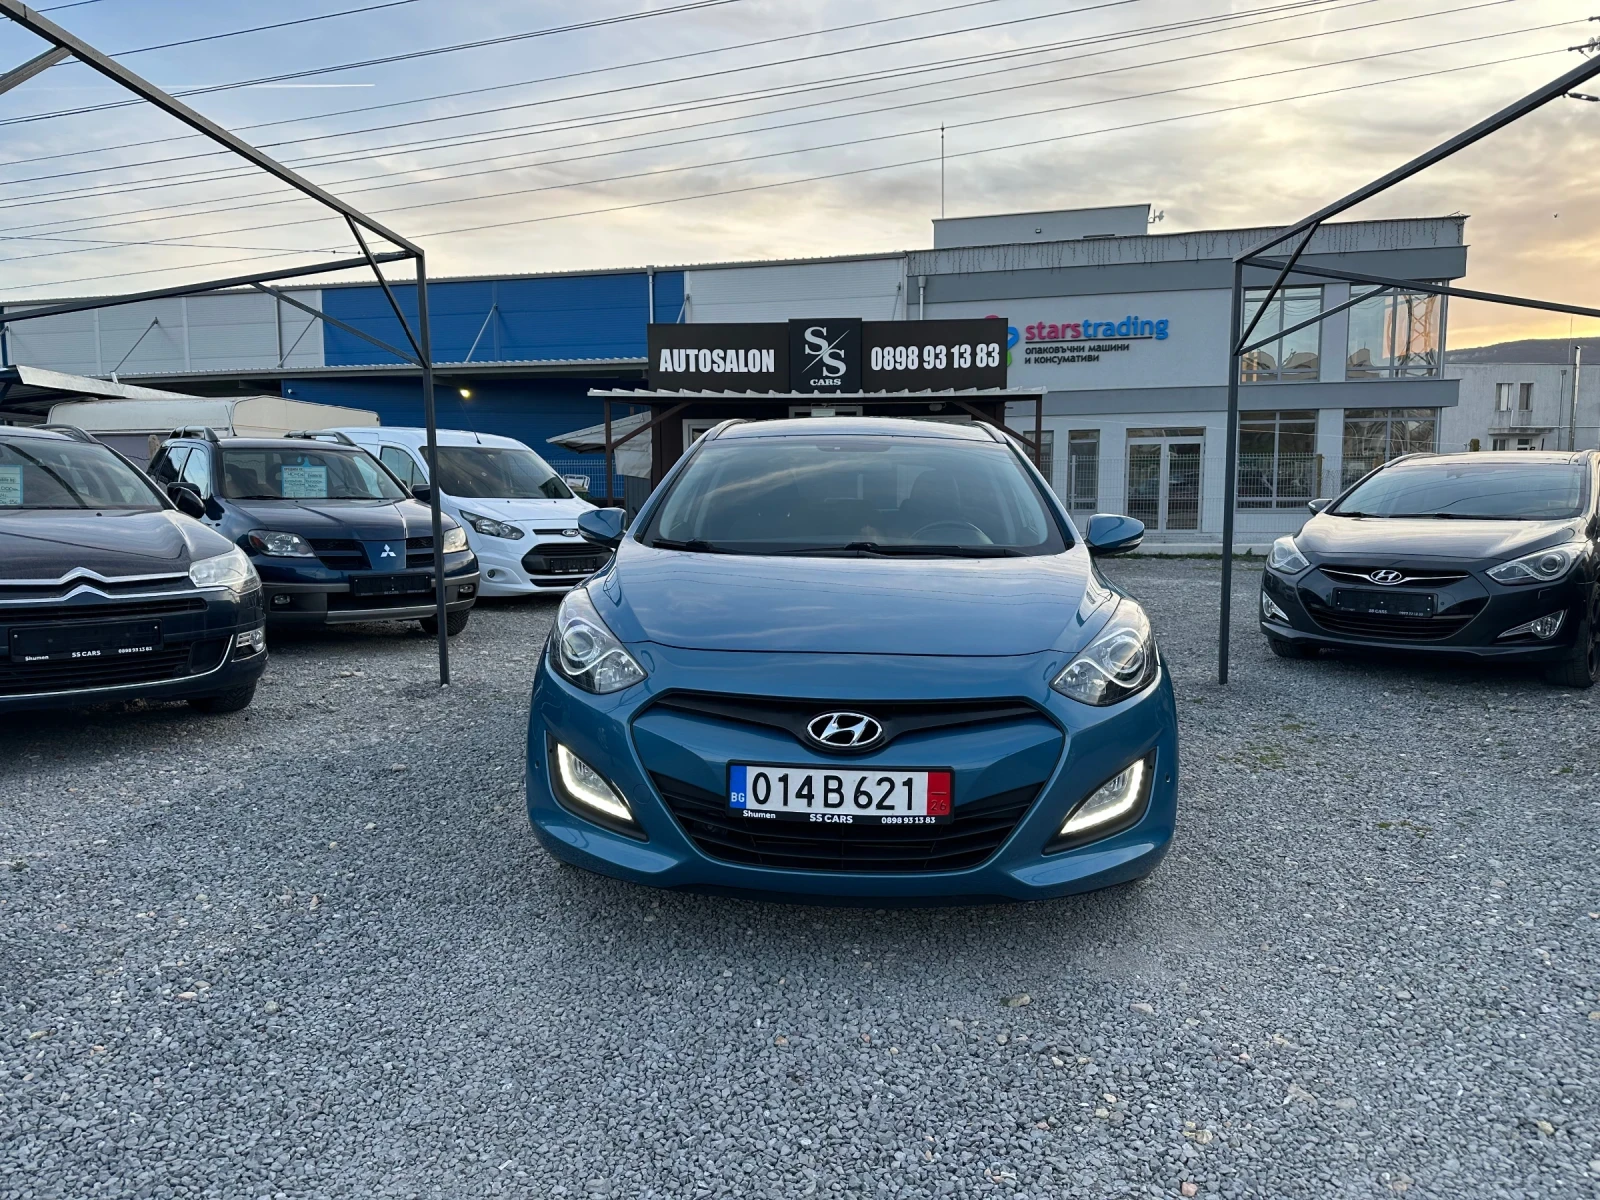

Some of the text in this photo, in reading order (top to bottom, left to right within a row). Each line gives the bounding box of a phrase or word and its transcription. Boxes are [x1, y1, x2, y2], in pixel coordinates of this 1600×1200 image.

[1025, 315, 1169, 340] starstrading
[1025, 343, 1130, 355] опаковъчни машини
[659, 348, 775, 373] AUTOSALON
[870, 343, 1000, 371] 0898 93 13 83
[1034, 354, 1100, 365] консумативи
[809, 378, 842, 386] CARS
[731, 792, 745, 802] BG
[930, 799, 947, 811] 26
[742, 809, 776, 819] Shumen
[809, 813, 823, 822] SS
[824, 814, 853, 824] CARS
